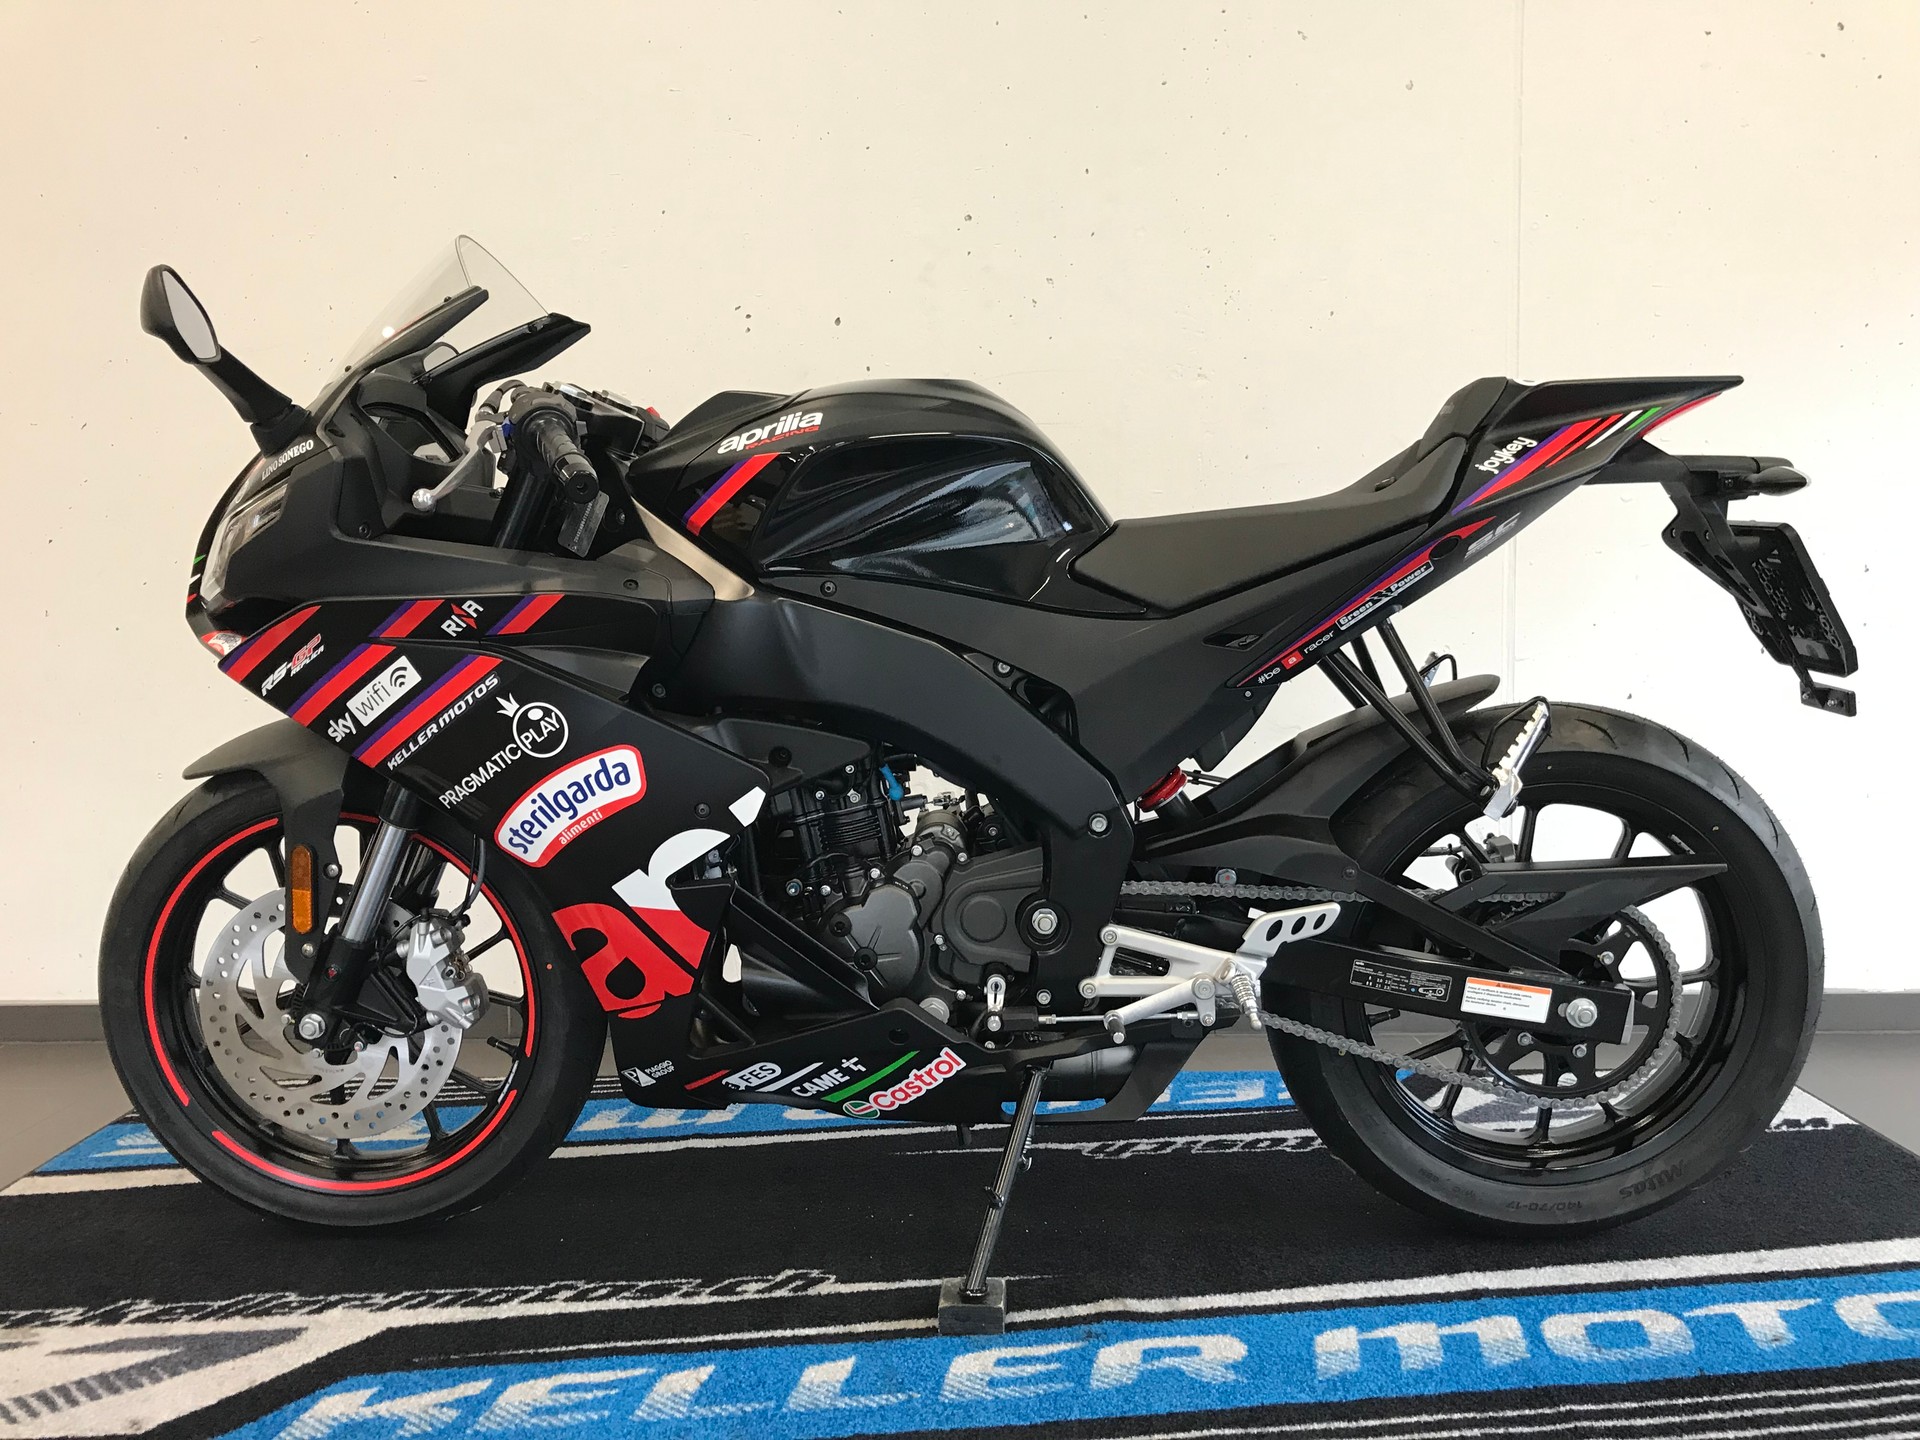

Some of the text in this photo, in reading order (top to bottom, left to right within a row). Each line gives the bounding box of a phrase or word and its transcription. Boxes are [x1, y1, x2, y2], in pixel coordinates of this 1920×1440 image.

[278, 439, 314, 467] SONEGO
[717, 412, 823, 454] aprilia
[745, 425, 820, 449] RACING
[1474, 436, 1538, 475] joykey
[1339, 566, 1428, 626] Green Power
[1303, 630, 1335, 654] racer
[327, 681, 391, 743] sky wifi
[387, 673, 500, 771] KELLER MOTOS
[438, 712, 561, 809] PRAGMATIC PLAY
[508, 757, 631, 855] sterilgarda
[558, 808, 603, 845] alimenti
[651, 1065, 675, 1079] GROUP
[791, 1068, 851, 1098] CAME
[870, 1048, 964, 1110] Castrol
[1619, 1159, 1687, 1199] Mitas
[264, 1333, 1249, 1440] KELLER
